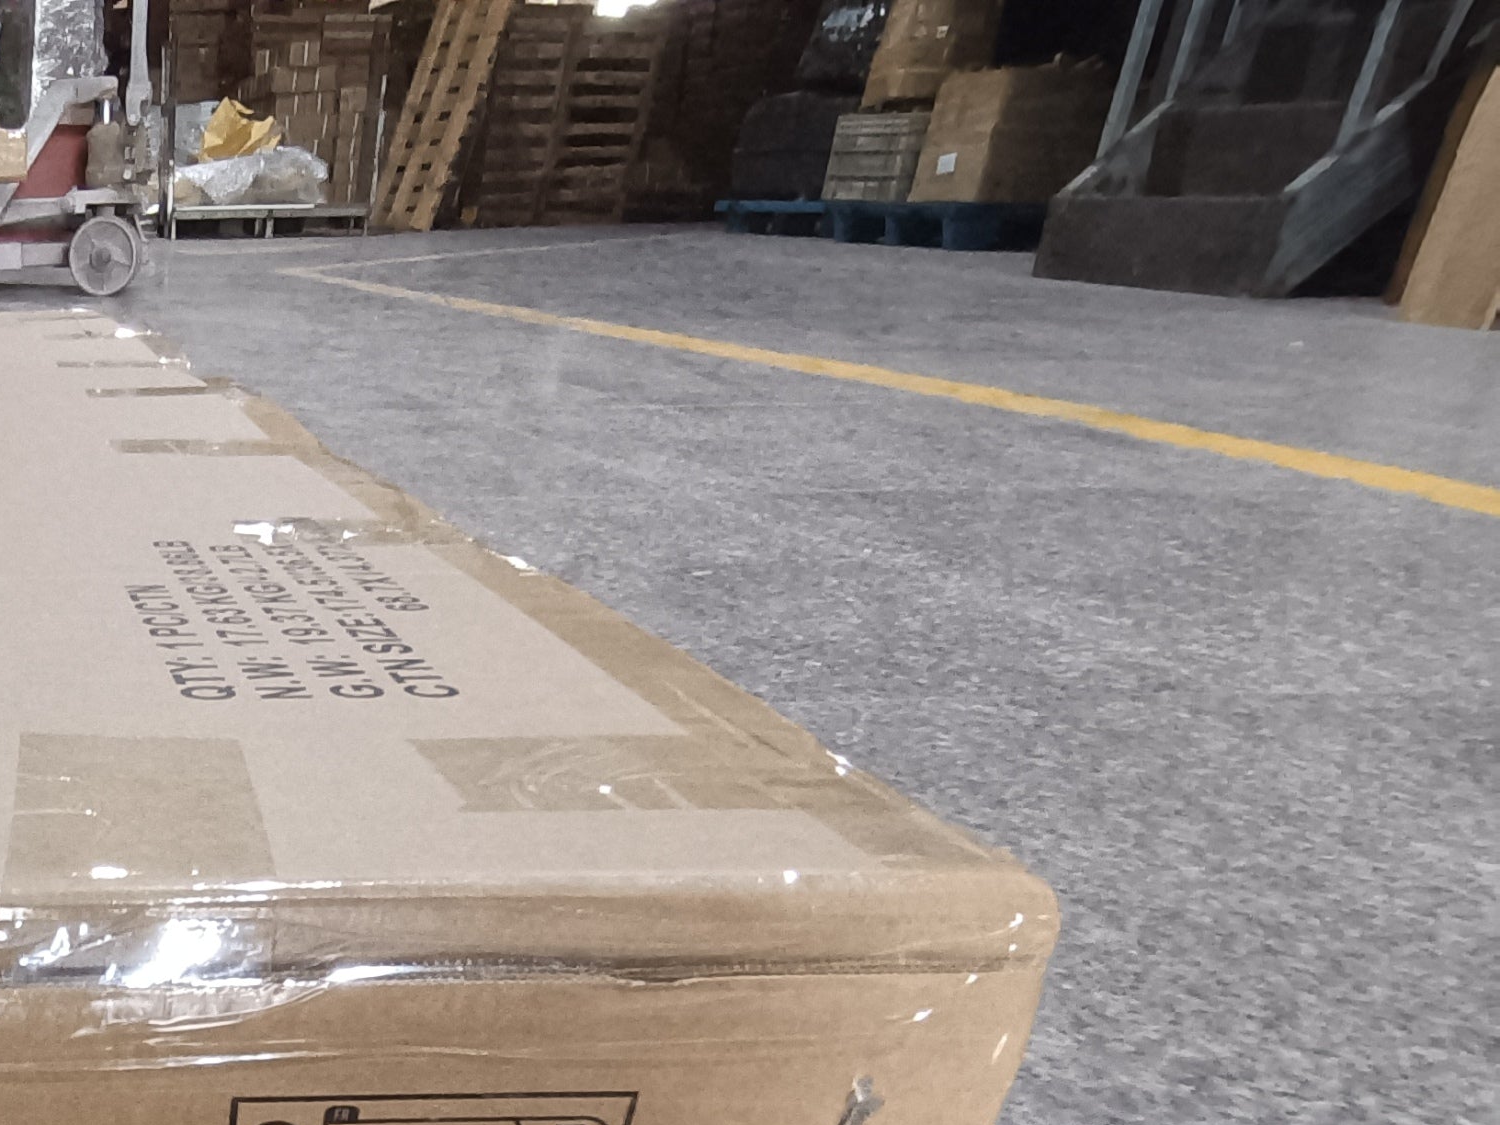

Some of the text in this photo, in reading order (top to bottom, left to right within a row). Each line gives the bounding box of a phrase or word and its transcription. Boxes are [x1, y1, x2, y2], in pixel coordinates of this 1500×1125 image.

[165, 657, 236, 700] QTY:
[237, 656, 313, 699] N.W:
[306, 655, 385, 698] G.W:
[377, 658, 460, 698] CTN
